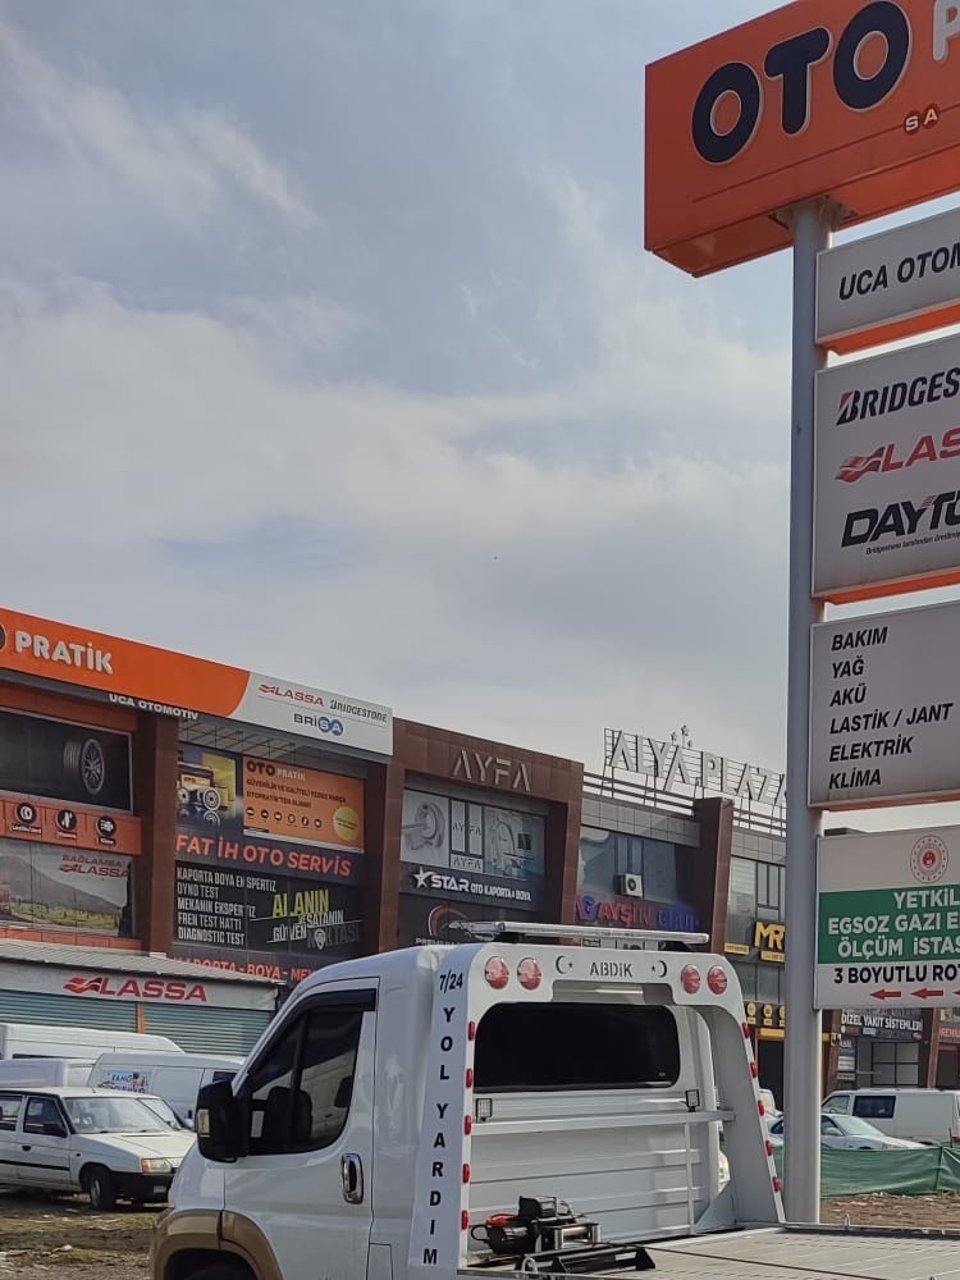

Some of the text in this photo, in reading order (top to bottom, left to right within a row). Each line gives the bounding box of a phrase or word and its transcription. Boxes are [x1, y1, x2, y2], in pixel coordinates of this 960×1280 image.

[691, 0, 913, 165] OTO
[839, 264, 889, 301] UCA
[831, 626, 888, 651] BAKIM
[15, 630, 113, 675] PRATİK
[831, 655, 865, 680] YAĞ
[108, 693, 199, 721] UCA OTOMOTİV
[275, 686, 388, 723] LASSA BRIDGESTONE
[829, 683, 867, 707] AKÜ
[293, 713, 344, 737] BRİSA
[829, 703, 953, 734] LASTİK / JANT
[608, 729, 691, 792] ALYA
[829, 736, 914, 762] ELEKTRİK
[246, 760, 276, 777] OTO
[452, 749, 531, 792] AYFA
[828, 768, 882, 790] KLİMA
[79, 863, 129, 878] LASSA
[242, 845, 284, 867] OTO
[287, 850, 353, 877] SERVİS
[176, 867, 213, 884] KAPORTA
[214, 872, 235, 887] BOYA
[430, 874, 469, 893] STAR
[200, 884, 220, 899] TEST
[178, 912, 242, 931] FREN TEST HATTI
[828, 914, 890, 935] EGSOZ
[895, 911, 941, 933] GAZI
[226, 931, 245, 945] TEST
[837, 938, 904, 961] ÖLÇÜM
[290, 967, 313, 981] ME
[439, 969, 464, 994] 7/24
[833, 967, 844, 984] 3
[847, 964, 927, 984] BOYUTLU
[100, 976, 208, 1003] LASSA
